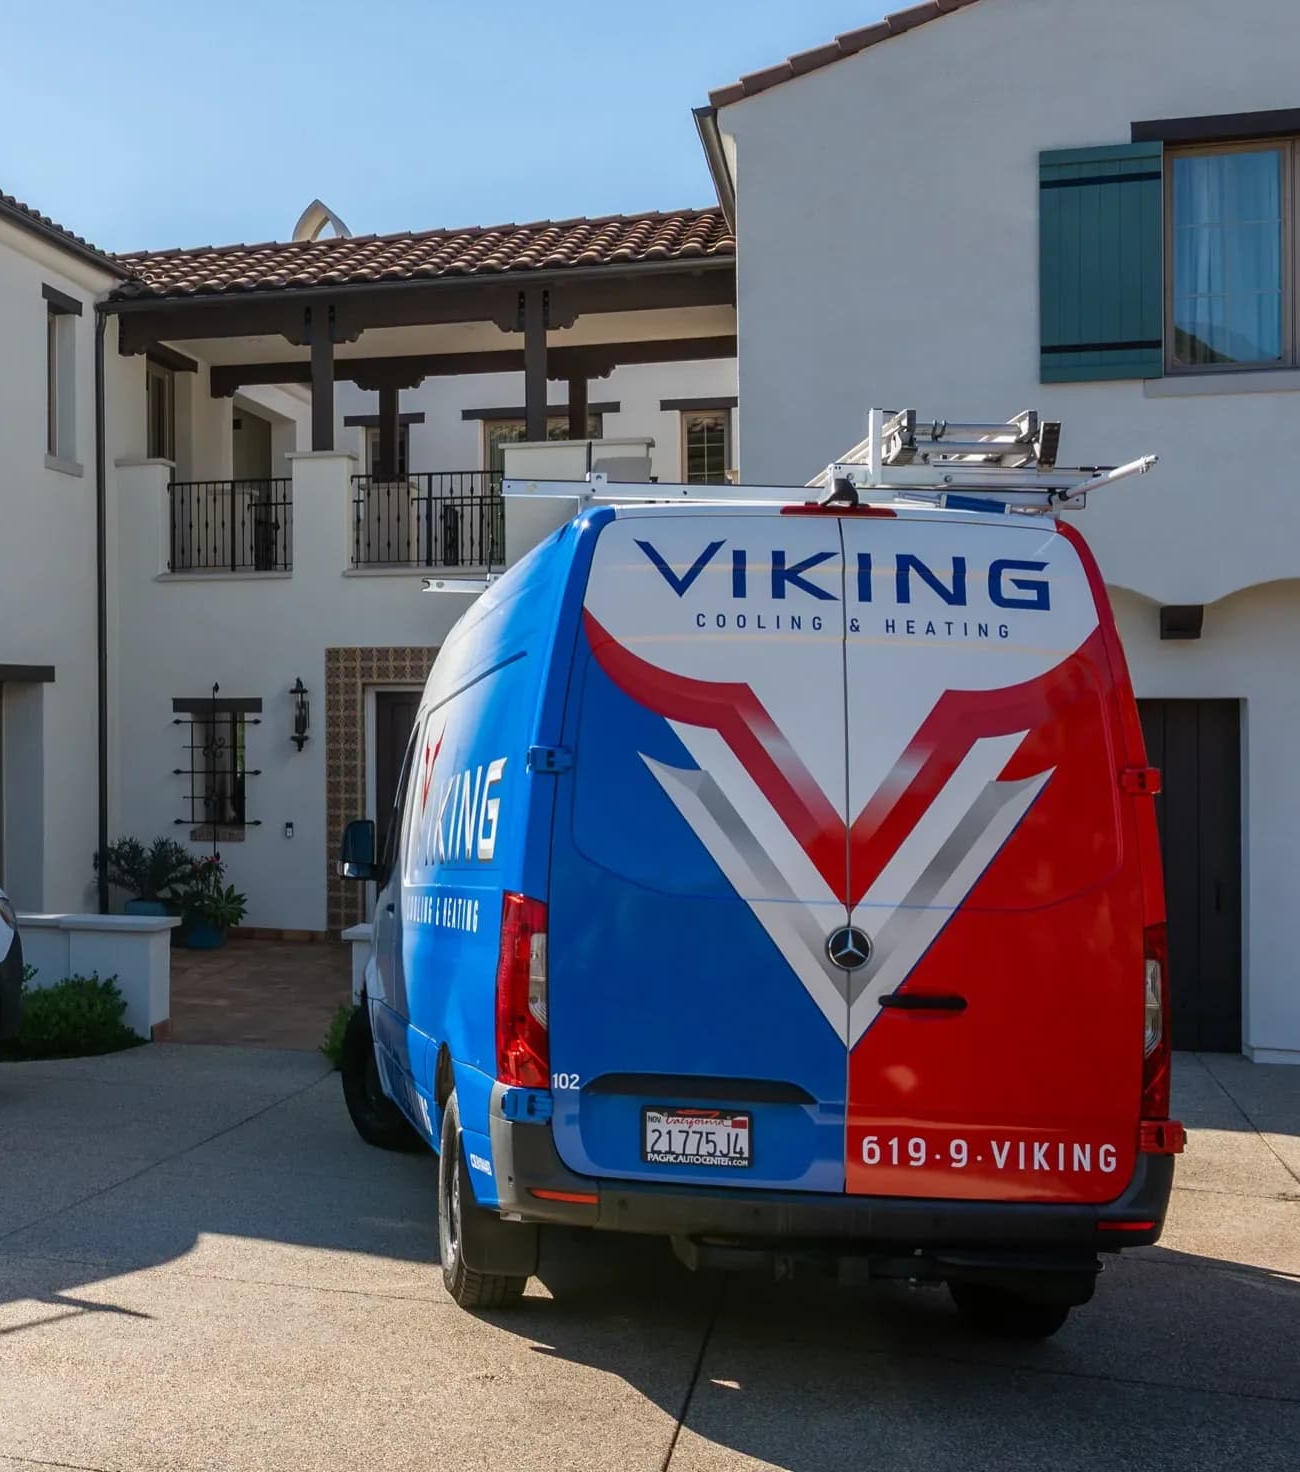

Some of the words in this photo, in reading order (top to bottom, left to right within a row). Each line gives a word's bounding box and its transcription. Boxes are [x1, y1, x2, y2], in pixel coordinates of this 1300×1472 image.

[633, 538, 1051, 611] VIKING
[696, 613, 823, 631] COOLING
[850, 618, 861, 633] &
[885, 618, 1010, 639] HEATING
[442, 897, 479, 933] HEATING
[552, 1073, 580, 1089] 102
[647, 1115, 661, 1123] NOV
[651, 1129, 744, 1156] 21775J4
